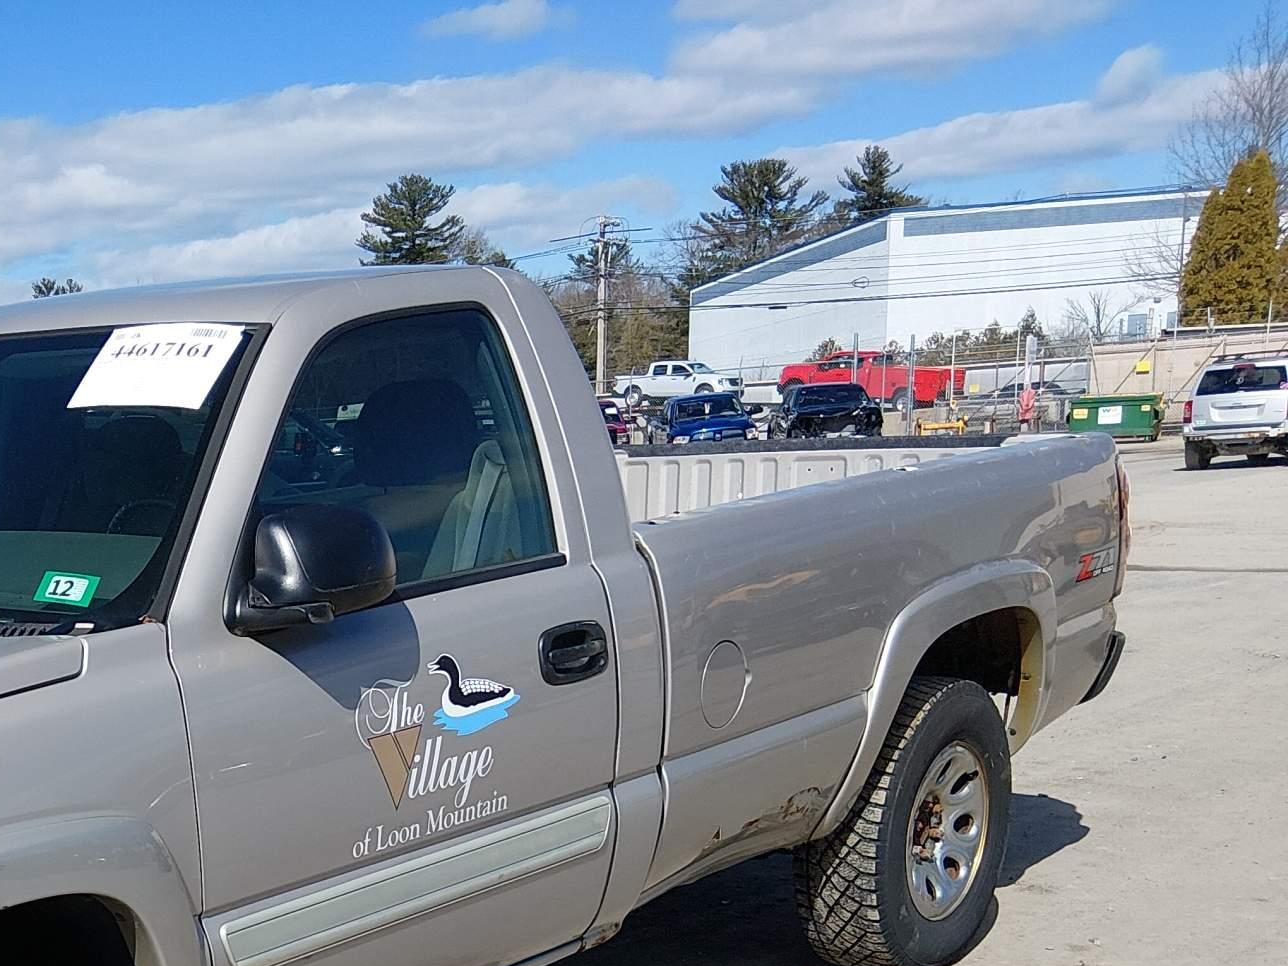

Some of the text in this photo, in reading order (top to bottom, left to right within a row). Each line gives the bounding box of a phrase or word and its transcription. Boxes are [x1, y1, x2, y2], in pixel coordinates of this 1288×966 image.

[111, 342, 214, 358] 44617161
[48, 579, 75, 597] 12
[1076, 546, 1115, 583] Z71
[355, 673, 425, 749] The
[367, 724, 495, 811] Village
[352, 790, 508, 858] of Loon Mountain
